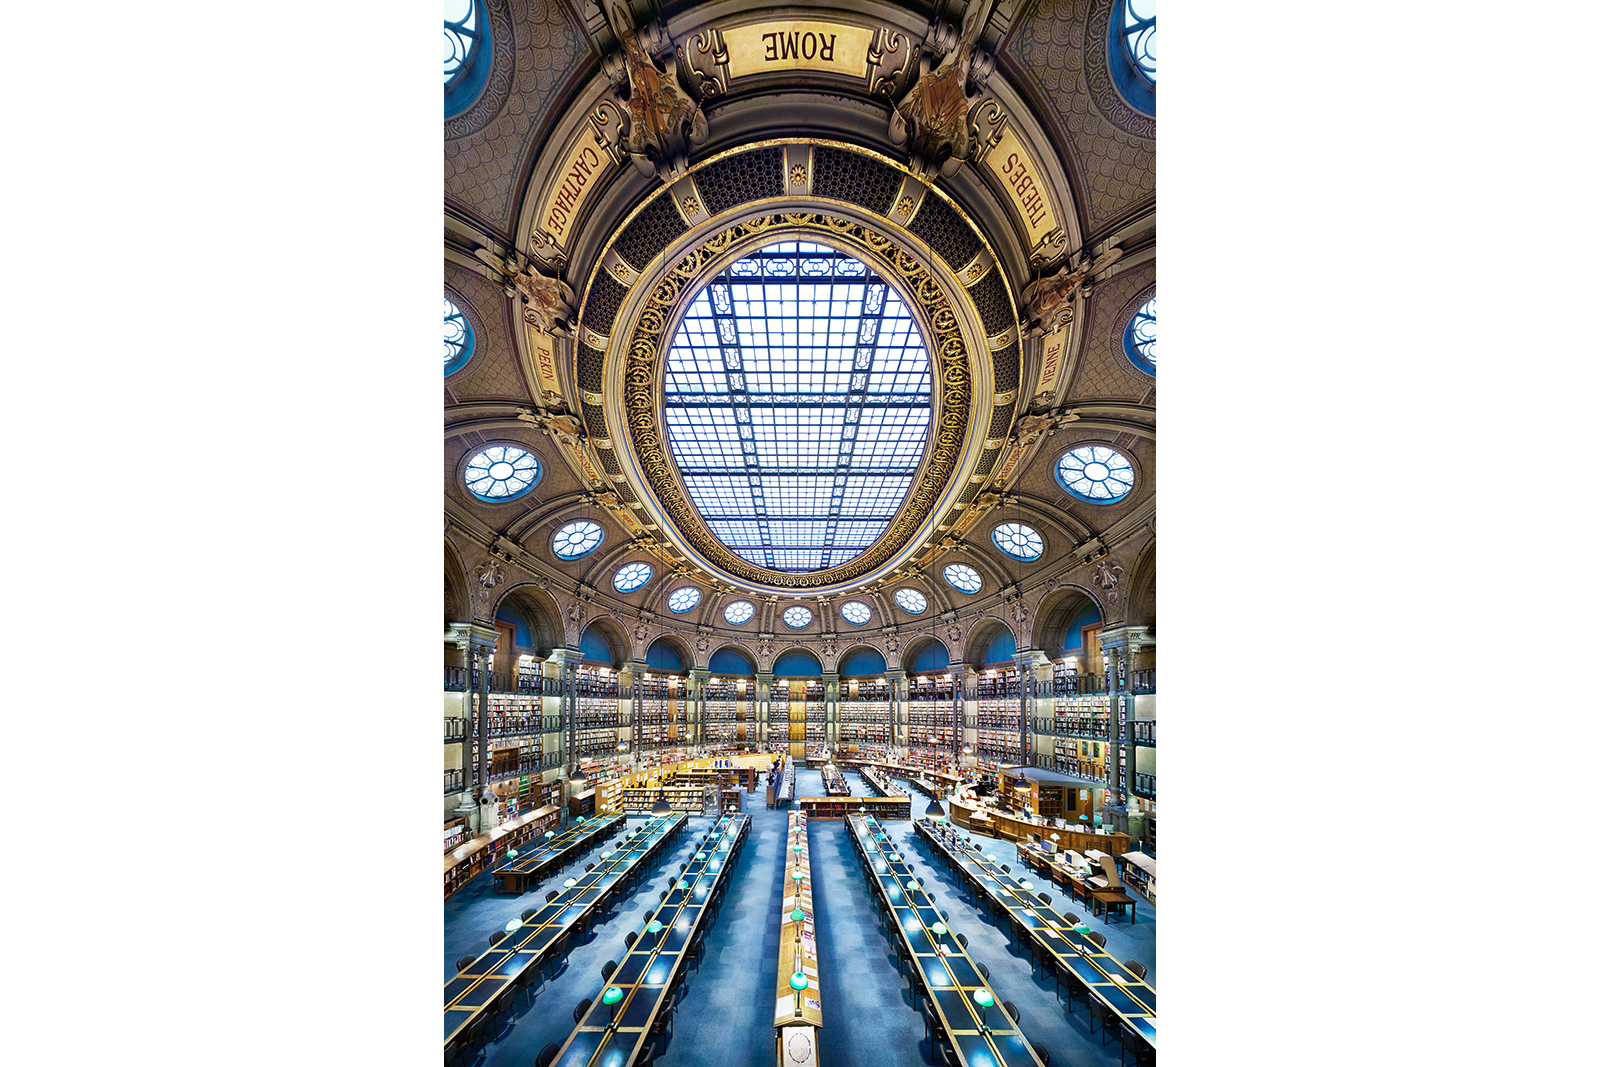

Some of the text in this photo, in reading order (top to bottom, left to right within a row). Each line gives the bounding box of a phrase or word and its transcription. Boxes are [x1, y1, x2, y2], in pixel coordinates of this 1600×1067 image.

[762, 32, 837, 62] ROME
[547, 147, 599, 236] CARTHAGE
[1001, 153, 1046, 229] THEBES
[537, 346, 555, 382] PEKIN
[1041, 343, 1060, 385] VIENNE
